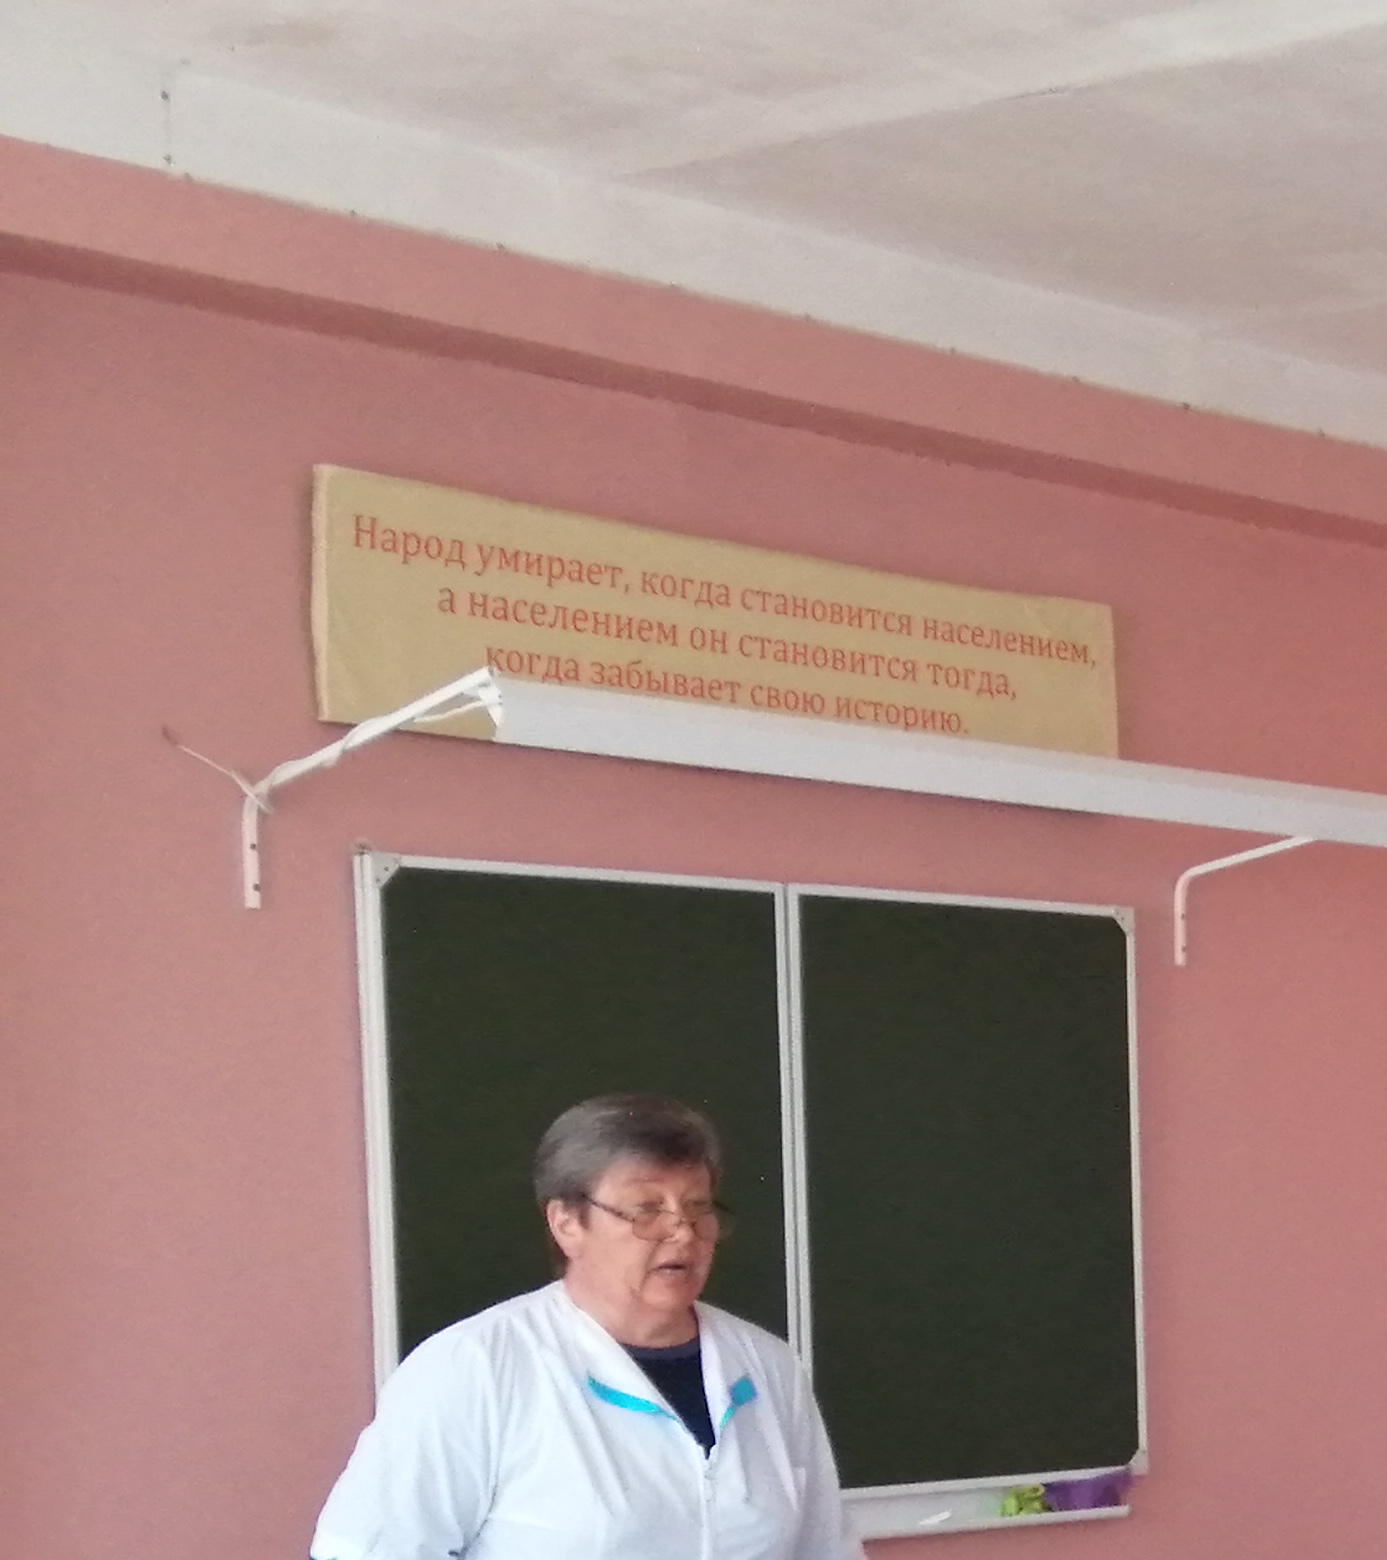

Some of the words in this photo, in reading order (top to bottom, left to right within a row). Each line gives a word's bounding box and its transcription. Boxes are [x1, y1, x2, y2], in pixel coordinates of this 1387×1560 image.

[353, 514, 466, 570] Народ
[474, 543, 630, 594] умирает,
[641, 571, 732, 610] когда
[740, 587, 912, 637] становится
[922, 617, 1097, 670] населением,
[437, 586, 456, 615] а
[468, 591, 679, 647] населением
[689, 626, 728, 655] он
[739, 634, 917, 682] становится
[926, 662, 1017, 700] тогда,
[486, 646, 580, 684] когда
[589, 659, 741, 703] забывает
[750, 683, 826, 714] свою
[834, 696, 969, 734] историю.
